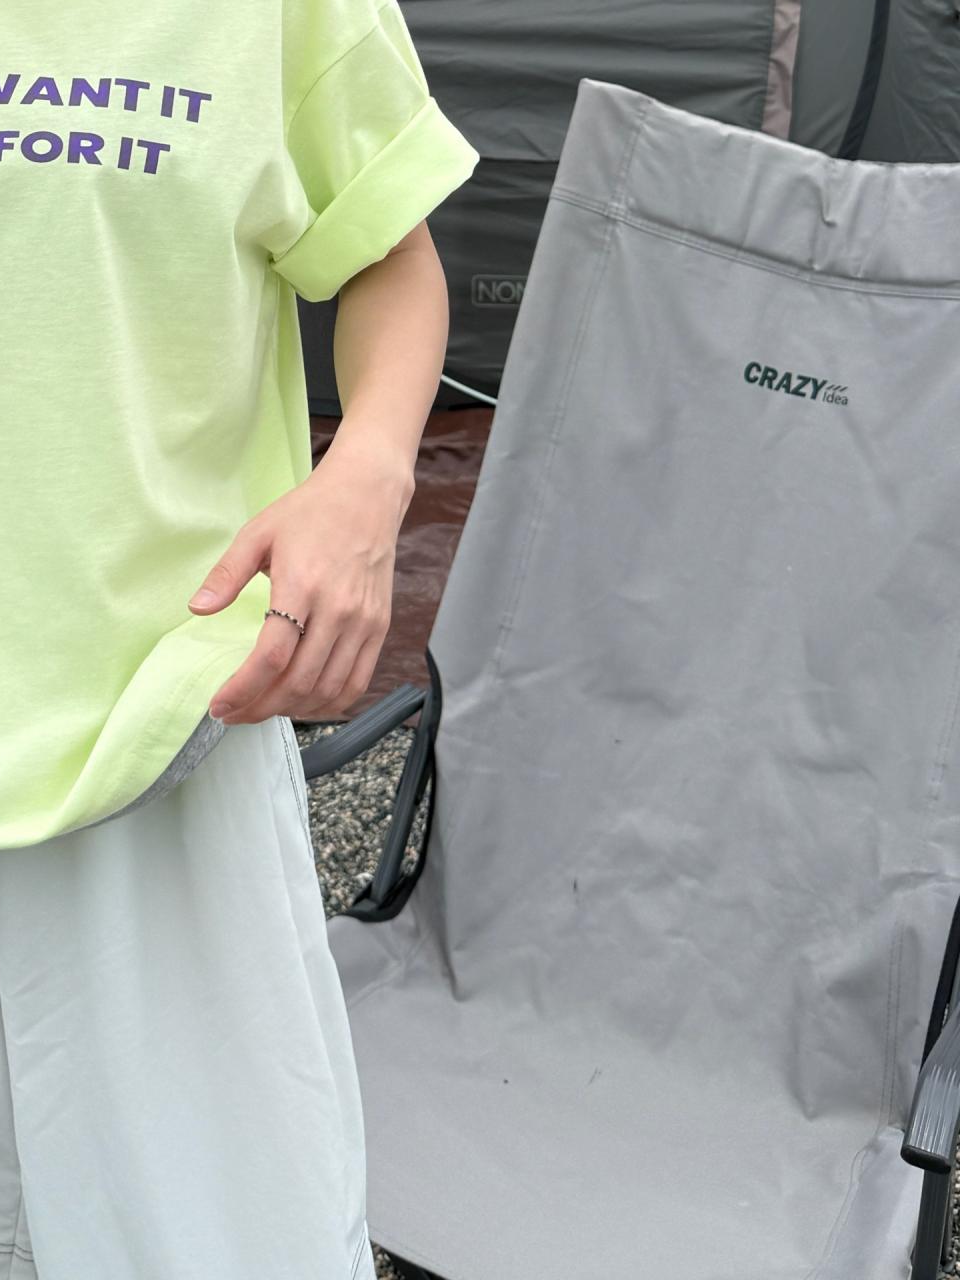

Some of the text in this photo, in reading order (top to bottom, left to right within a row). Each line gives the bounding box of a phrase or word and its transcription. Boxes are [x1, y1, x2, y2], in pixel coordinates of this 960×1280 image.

[160, 85, 213, 123] IT
[117, 136, 171, 175] IT
[743, 361, 828, 400] CRAZY
